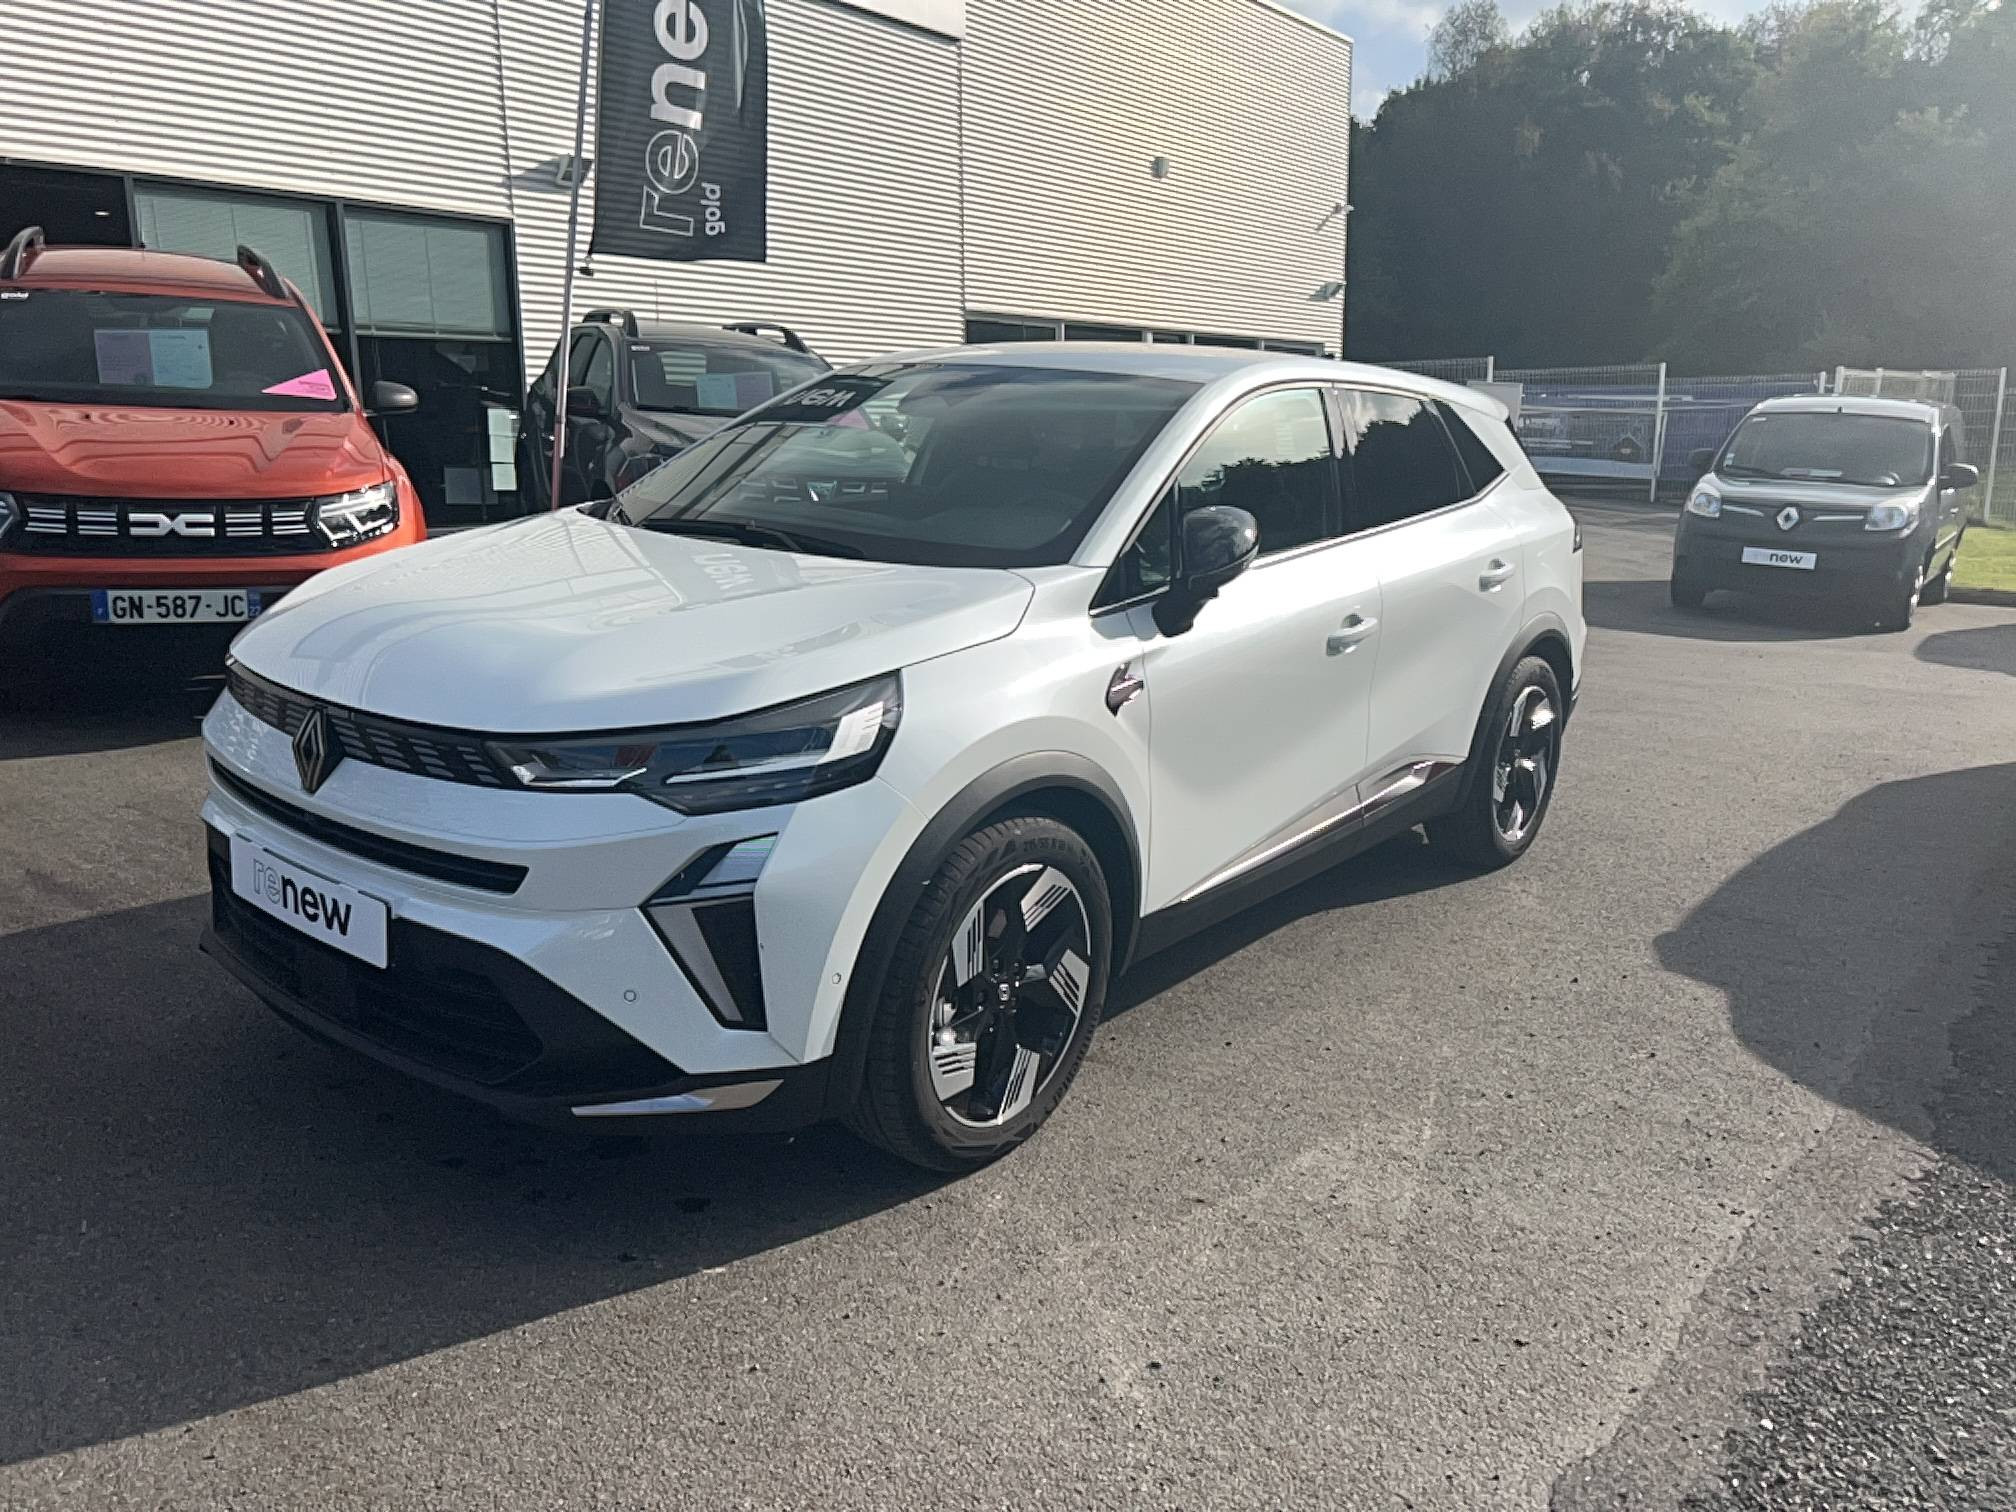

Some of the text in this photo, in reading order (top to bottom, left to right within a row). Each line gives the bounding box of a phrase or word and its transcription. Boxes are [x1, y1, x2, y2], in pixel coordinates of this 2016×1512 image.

[700, 182, 726, 236] gold
[111, 594, 245, 619] GN-587-JC
[253, 858, 352, 937] renew
